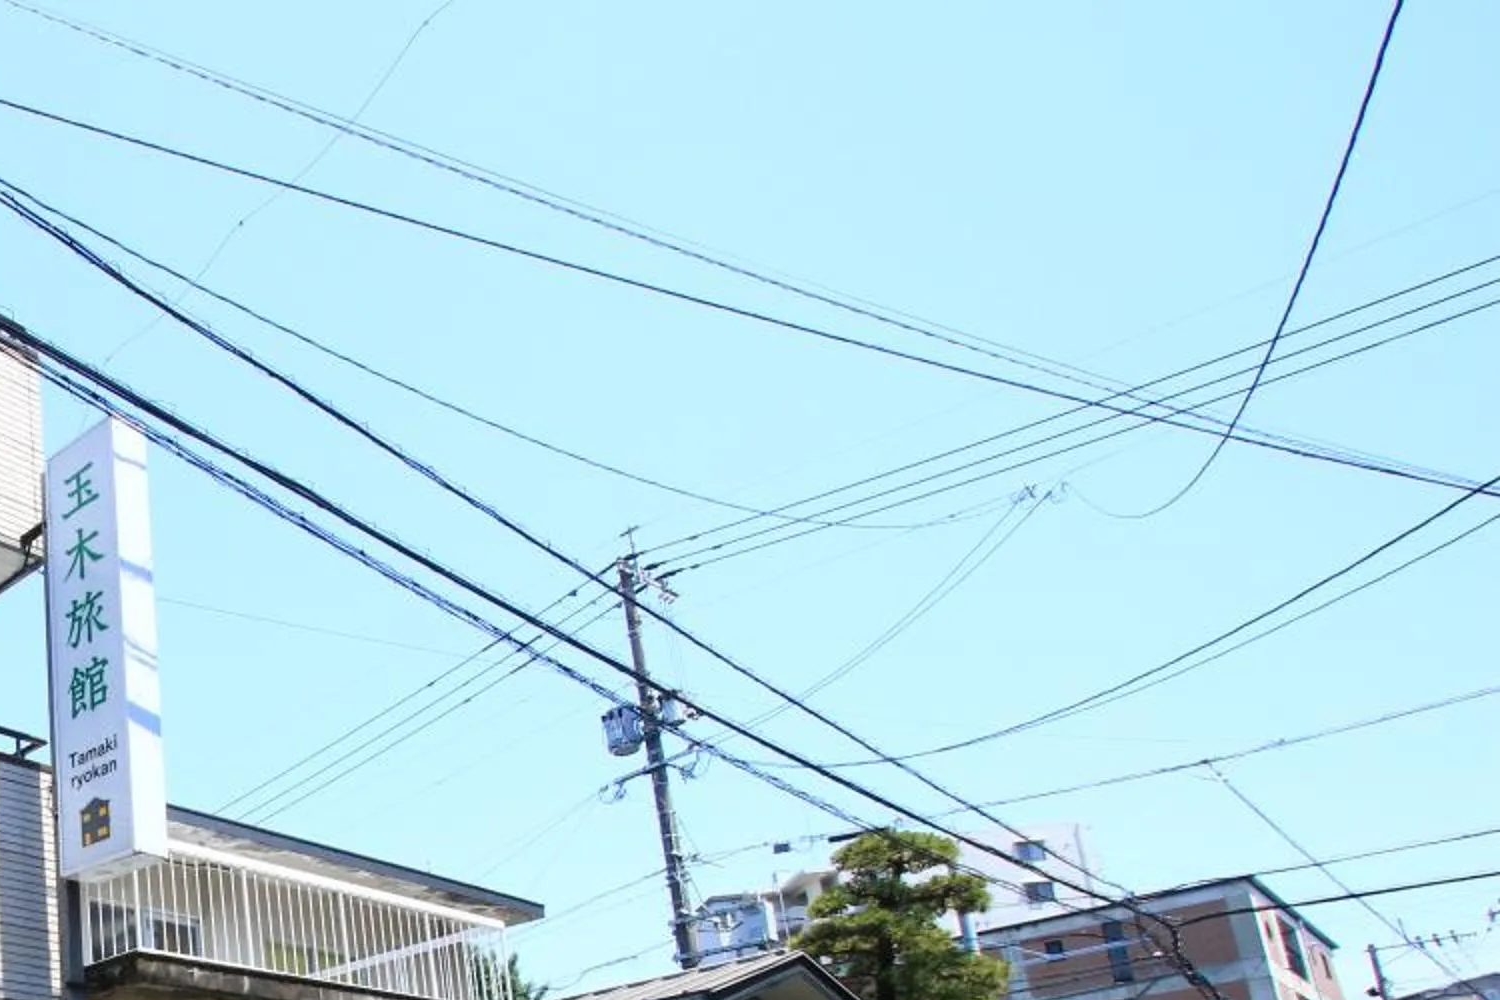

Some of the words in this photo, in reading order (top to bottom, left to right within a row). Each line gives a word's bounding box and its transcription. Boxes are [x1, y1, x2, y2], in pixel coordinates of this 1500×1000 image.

[62, 462, 109, 719] 玉木旅館
[68, 733, 118, 769] Tamaki
[70, 759, 118, 792] ryokan
